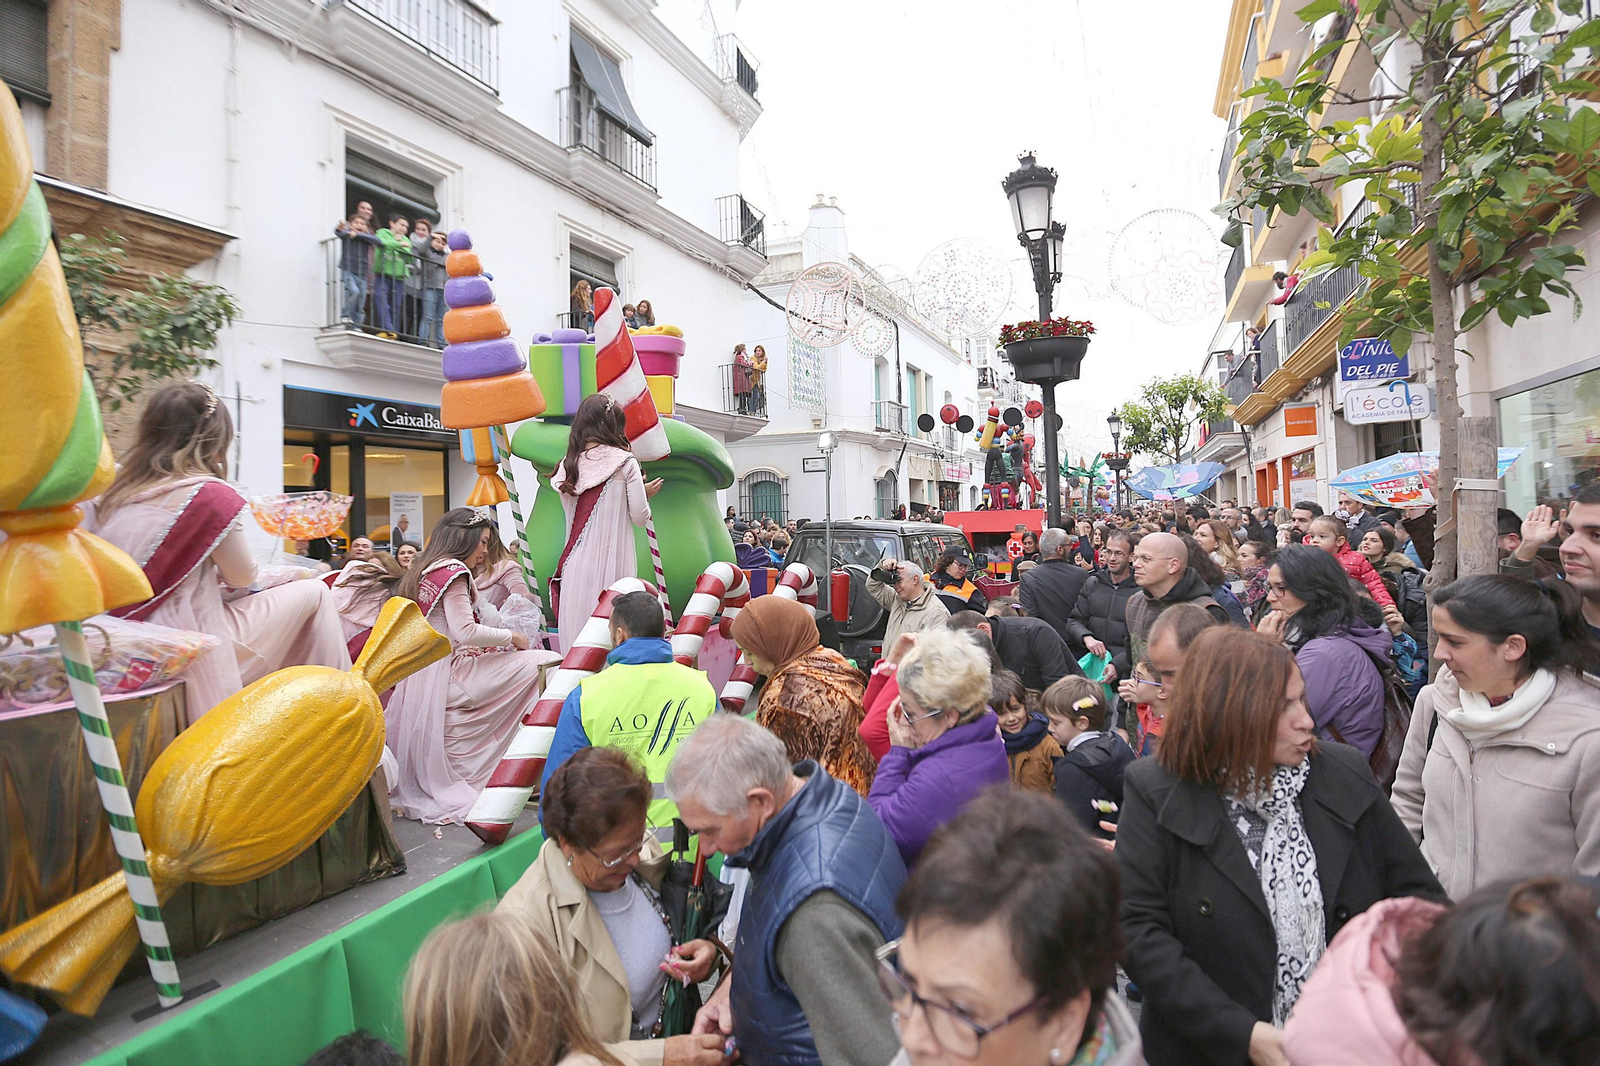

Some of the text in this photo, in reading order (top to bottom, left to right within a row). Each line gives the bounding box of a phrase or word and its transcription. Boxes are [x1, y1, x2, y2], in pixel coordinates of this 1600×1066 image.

[1346, 362, 1400, 377] DEL PIE
[1350, 394, 1423, 412] l'écoe
[381, 406, 456, 431] CaixaBa
